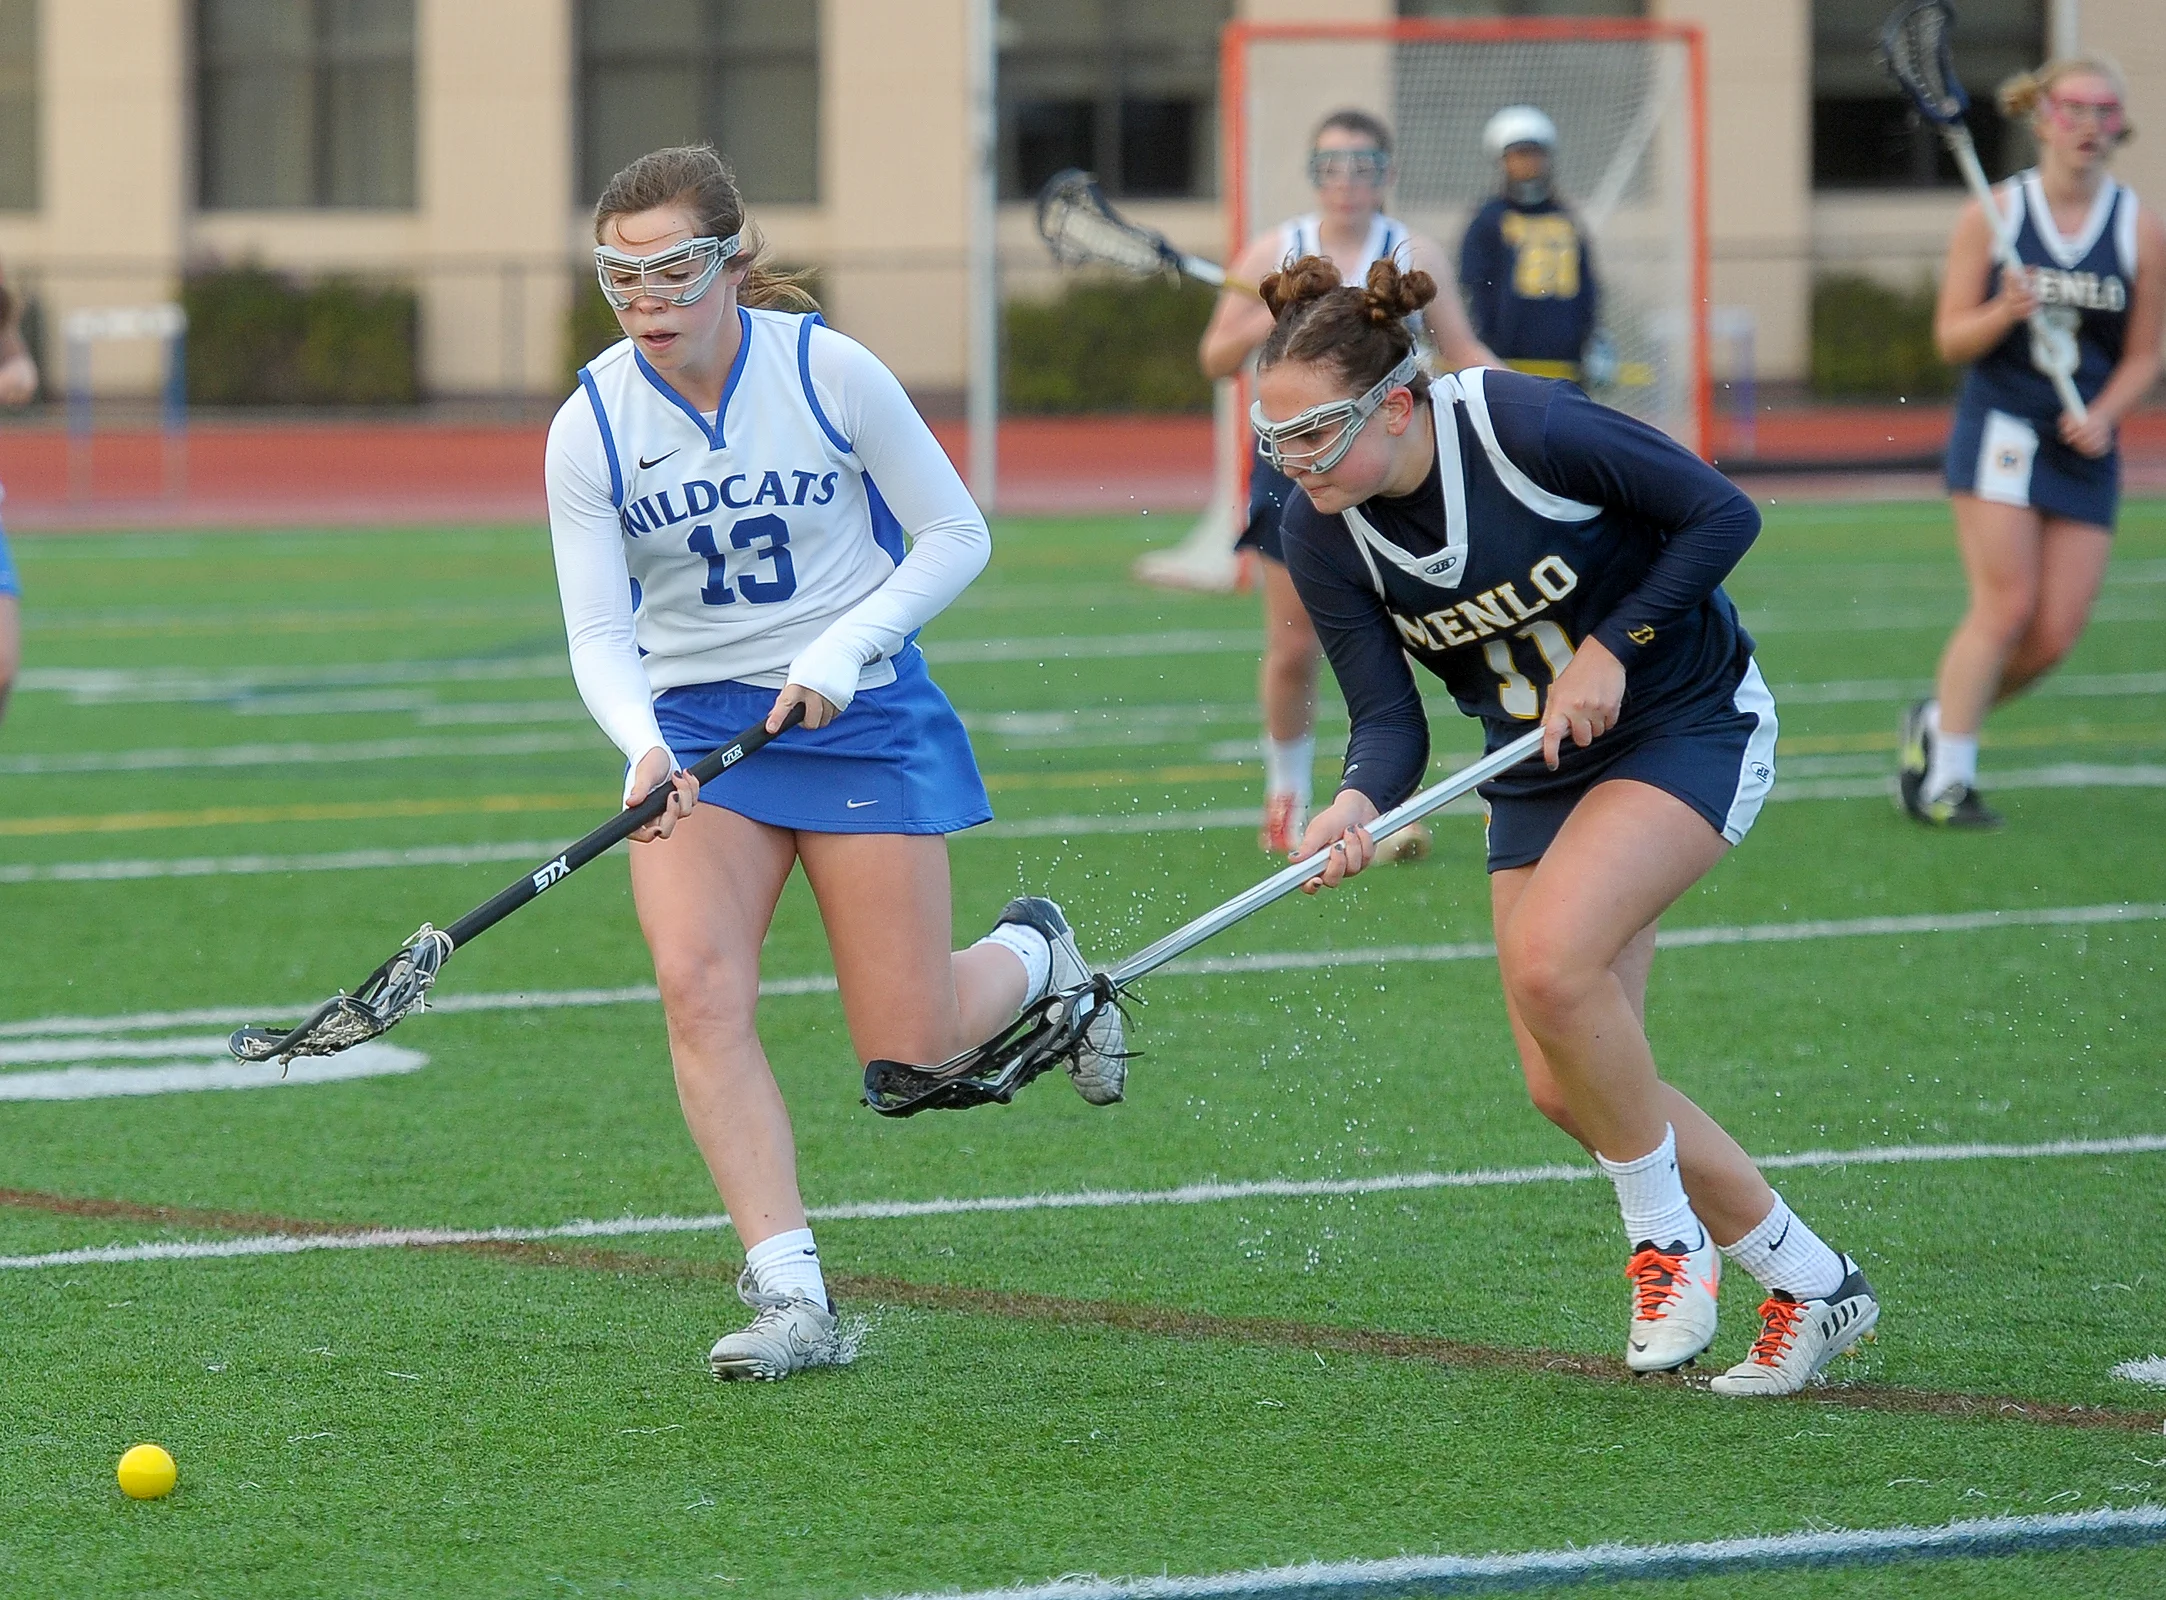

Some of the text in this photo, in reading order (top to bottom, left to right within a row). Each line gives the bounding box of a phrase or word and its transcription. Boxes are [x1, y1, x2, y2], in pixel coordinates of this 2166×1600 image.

[2036, 267, 2126, 312] ENLO
[1371, 370, 1400, 405] STX
[622, 469, 838, 539] WILDCATS
[686, 513, 798, 606] 13
[1391, 555, 1579, 650] MENLO
[532, 854, 571, 893] STX
